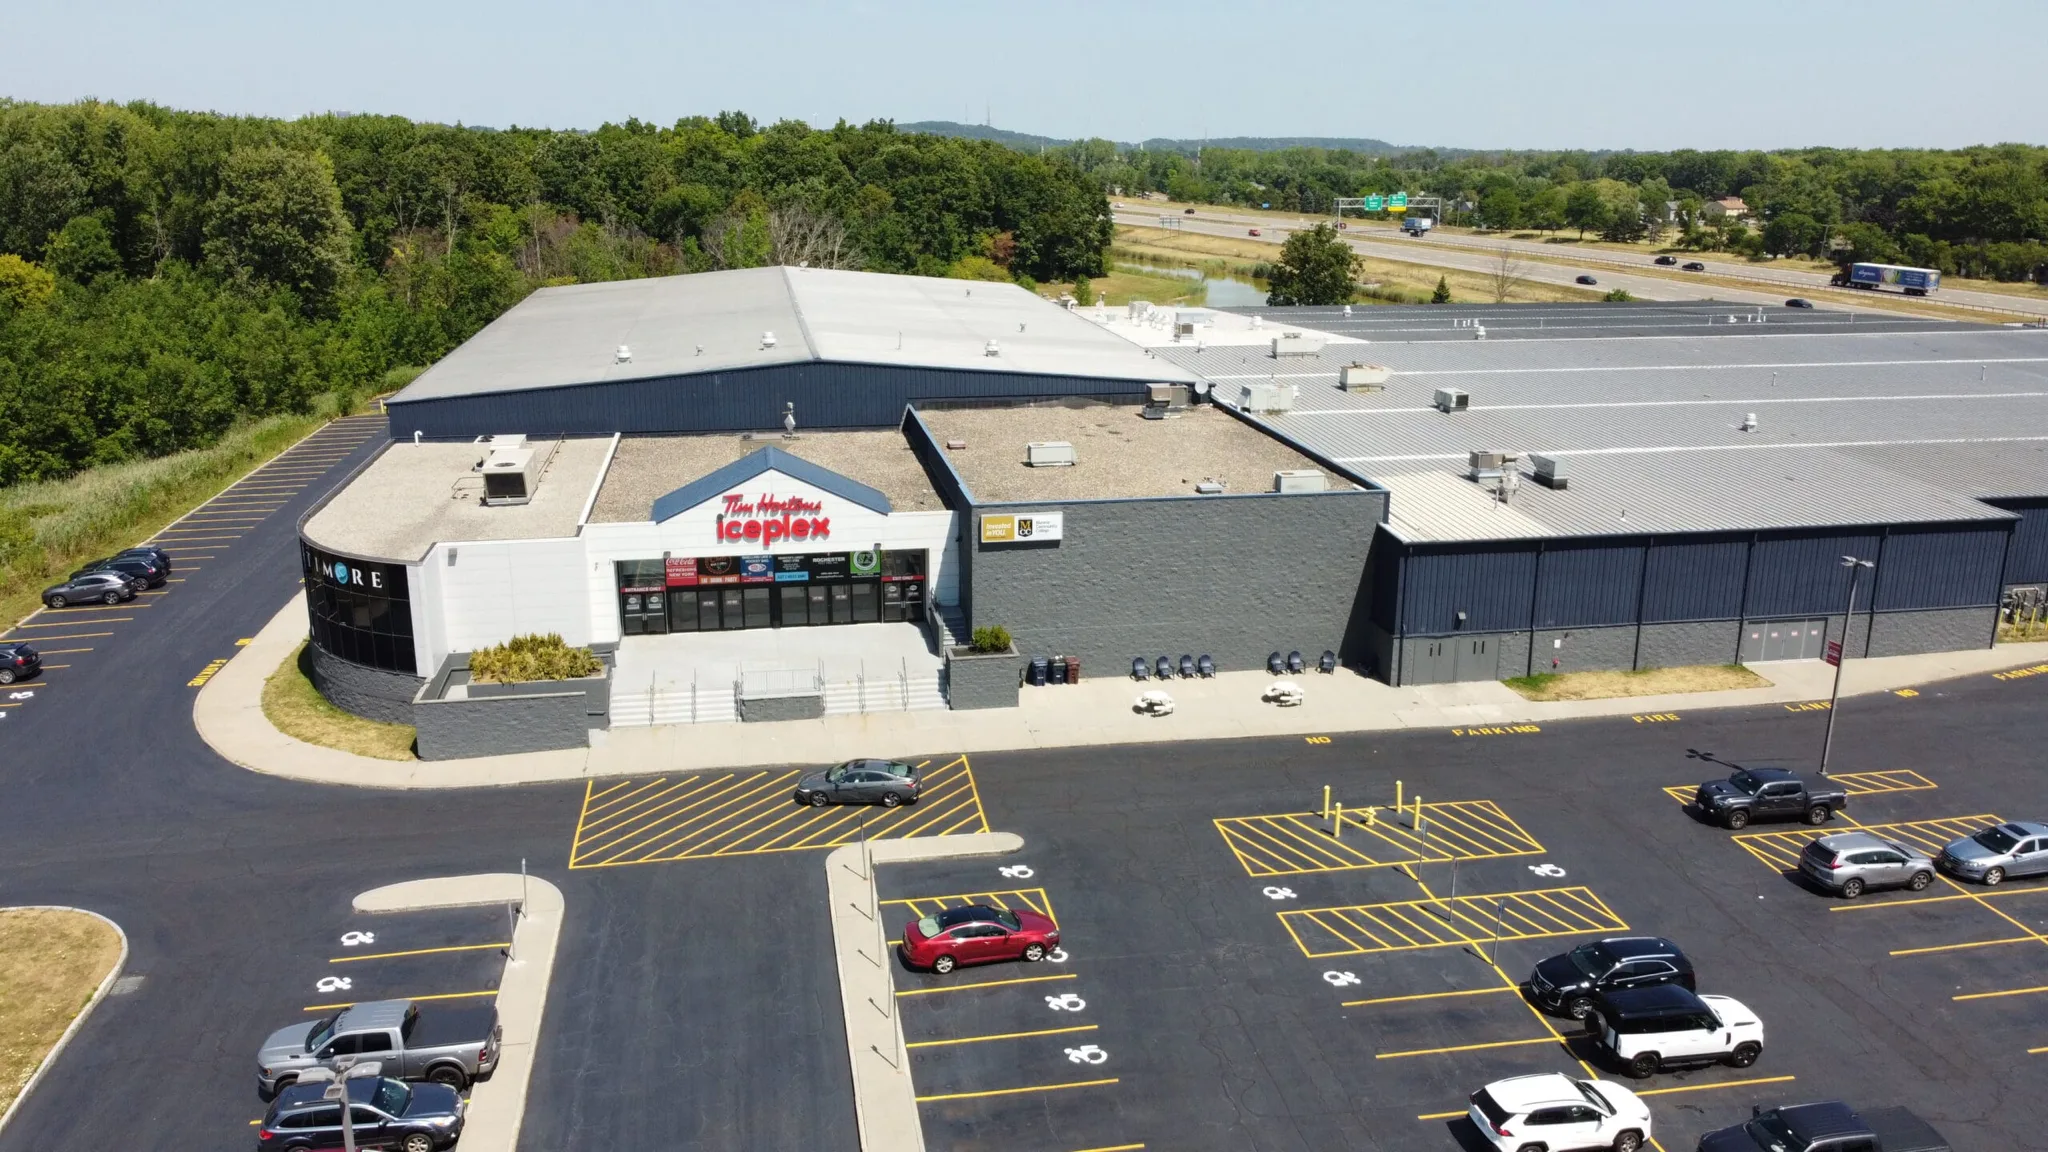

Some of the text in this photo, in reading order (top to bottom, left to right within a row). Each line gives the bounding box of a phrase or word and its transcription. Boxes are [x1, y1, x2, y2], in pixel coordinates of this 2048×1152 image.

[722, 493, 822, 514] Tim Hortons
[716, 513, 831, 548] iceplex
[1992, 664, 2048, 681] PARKIN
[1784, 701, 1832, 712] LANE
[1631, 713, 1681, 723] FIRE
[1451, 725, 1541, 737] PARKING
[1304, 736, 1331, 745] NO
